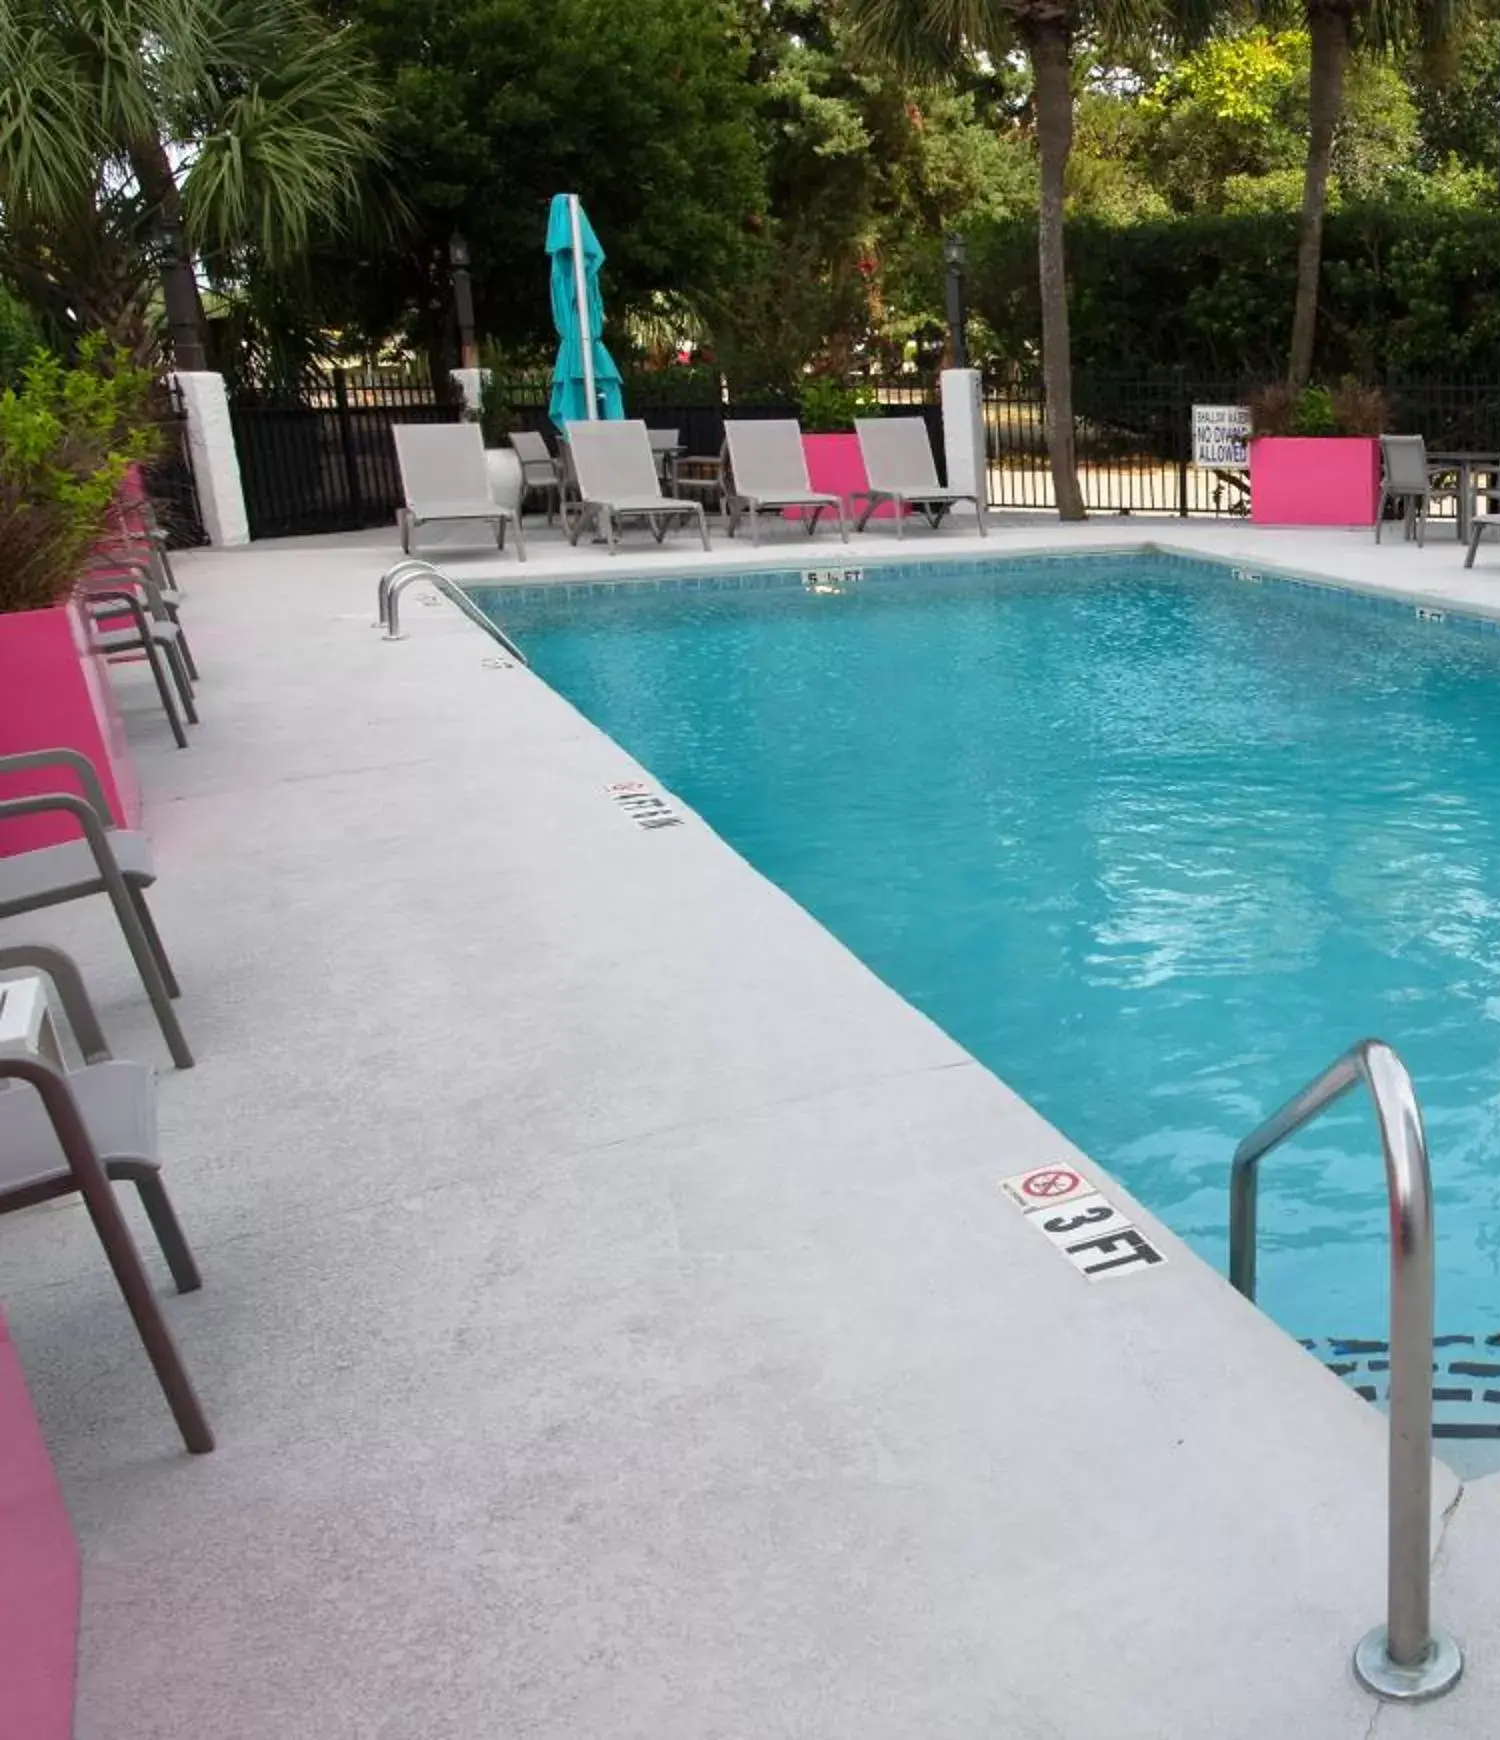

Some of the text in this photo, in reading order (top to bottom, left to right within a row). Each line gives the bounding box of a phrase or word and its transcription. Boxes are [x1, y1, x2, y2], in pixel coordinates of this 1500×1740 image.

[1199, 444, 1247, 463] ALLOWED
[1043, 1206, 1163, 1275] 3 FT
